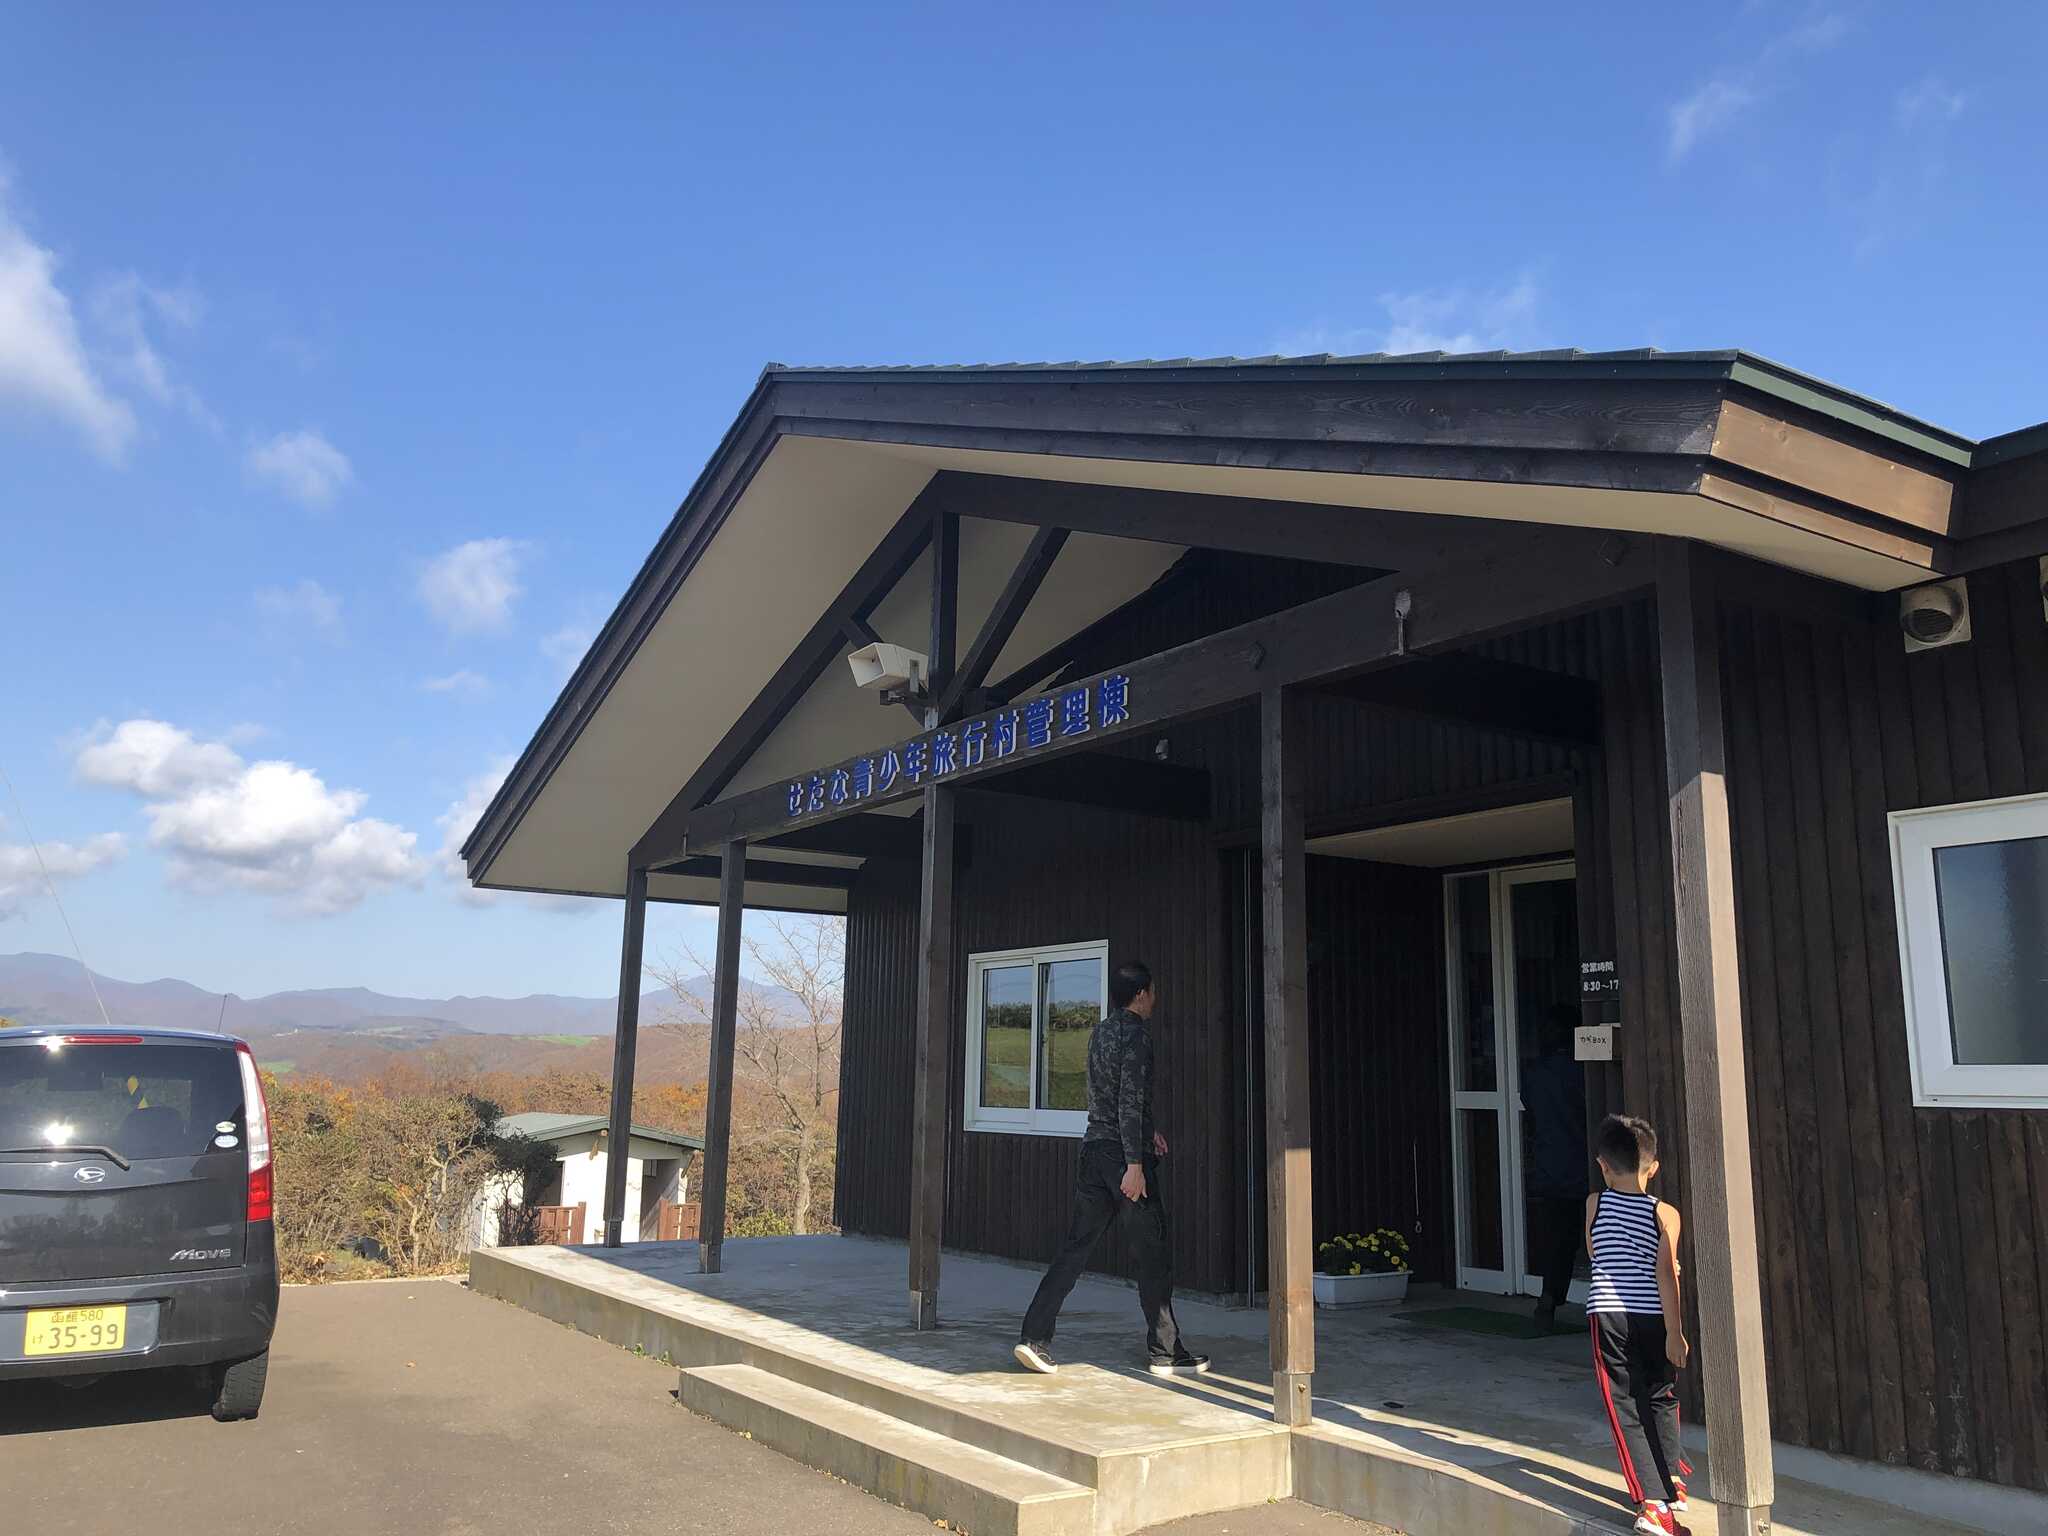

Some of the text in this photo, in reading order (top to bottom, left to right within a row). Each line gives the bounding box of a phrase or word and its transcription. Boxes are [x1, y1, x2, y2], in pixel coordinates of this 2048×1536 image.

[787, 675, 1130, 817] せたな青少年旅行村管理棟
[1581, 961, 1614, 974] 営業時間
[80, 1309, 103, 1321] 580
[48, 1323, 119, 1349] 35-99
